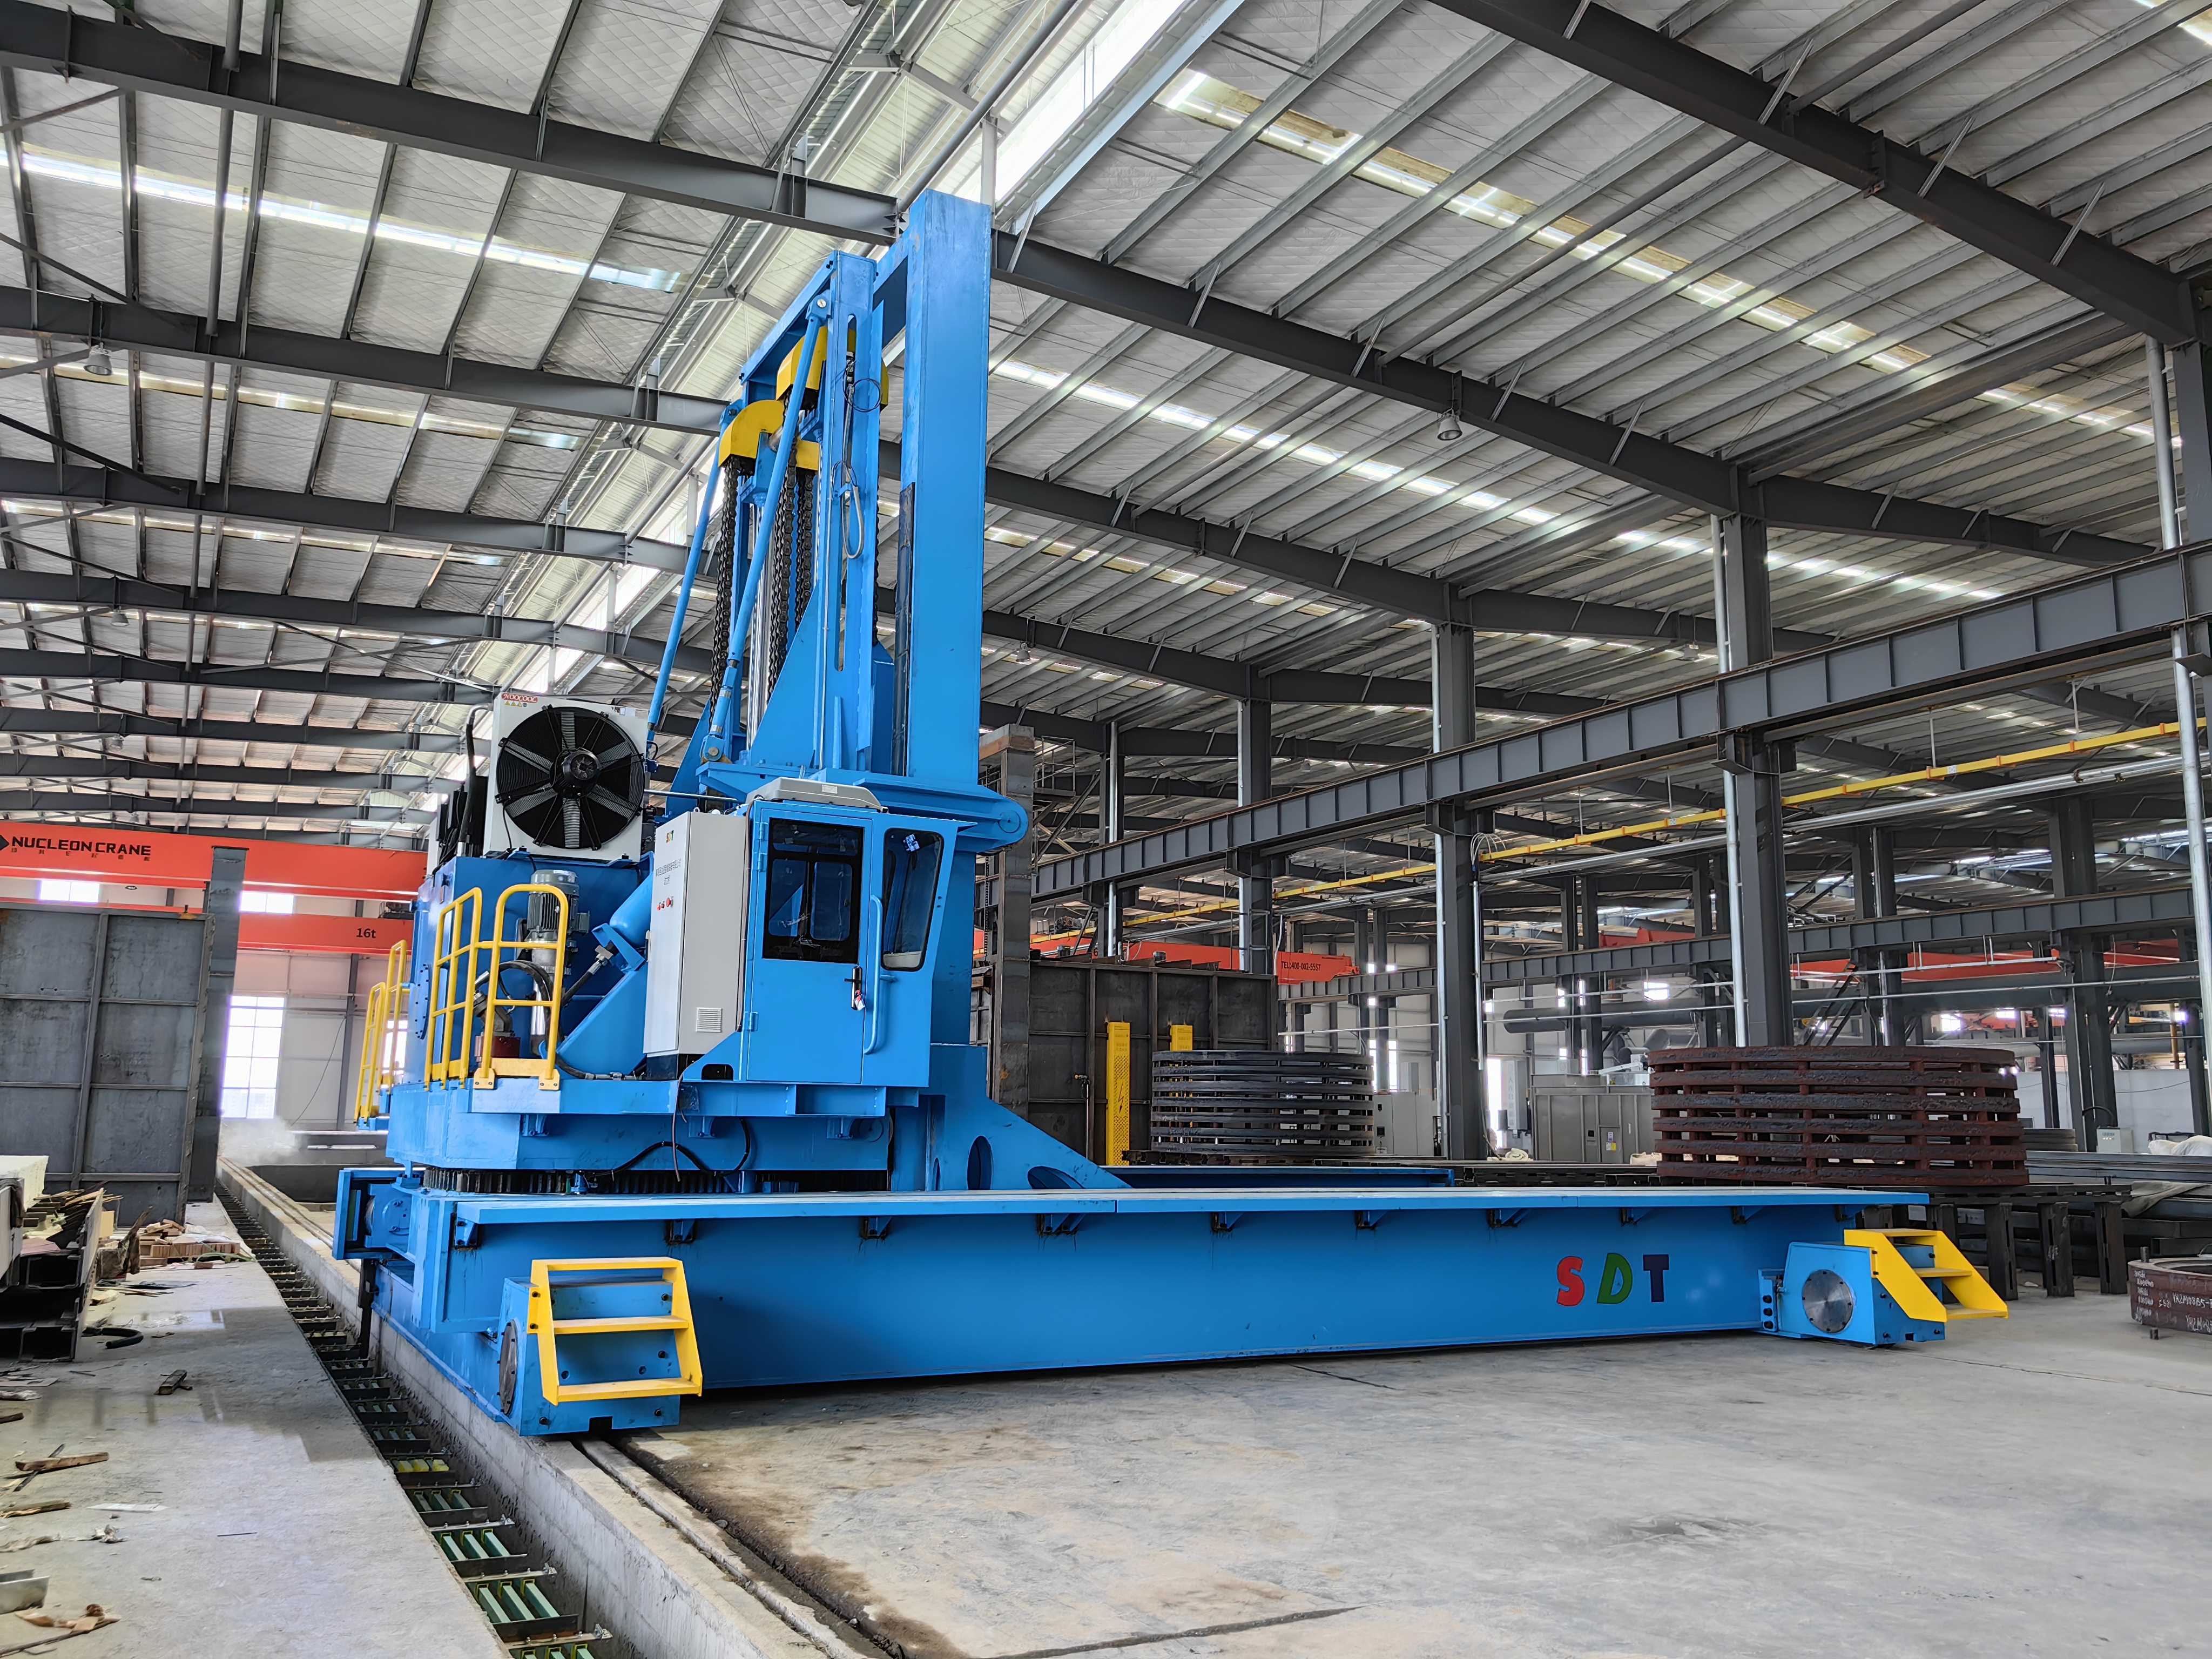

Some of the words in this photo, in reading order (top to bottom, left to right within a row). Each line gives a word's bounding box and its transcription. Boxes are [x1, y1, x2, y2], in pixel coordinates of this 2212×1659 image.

[12, 836, 92, 852] NUCLEON
[95, 842, 151, 856] CRANE
[356, 928, 376, 939] 16t
[1556, 1252, 1669, 1306] SDT
